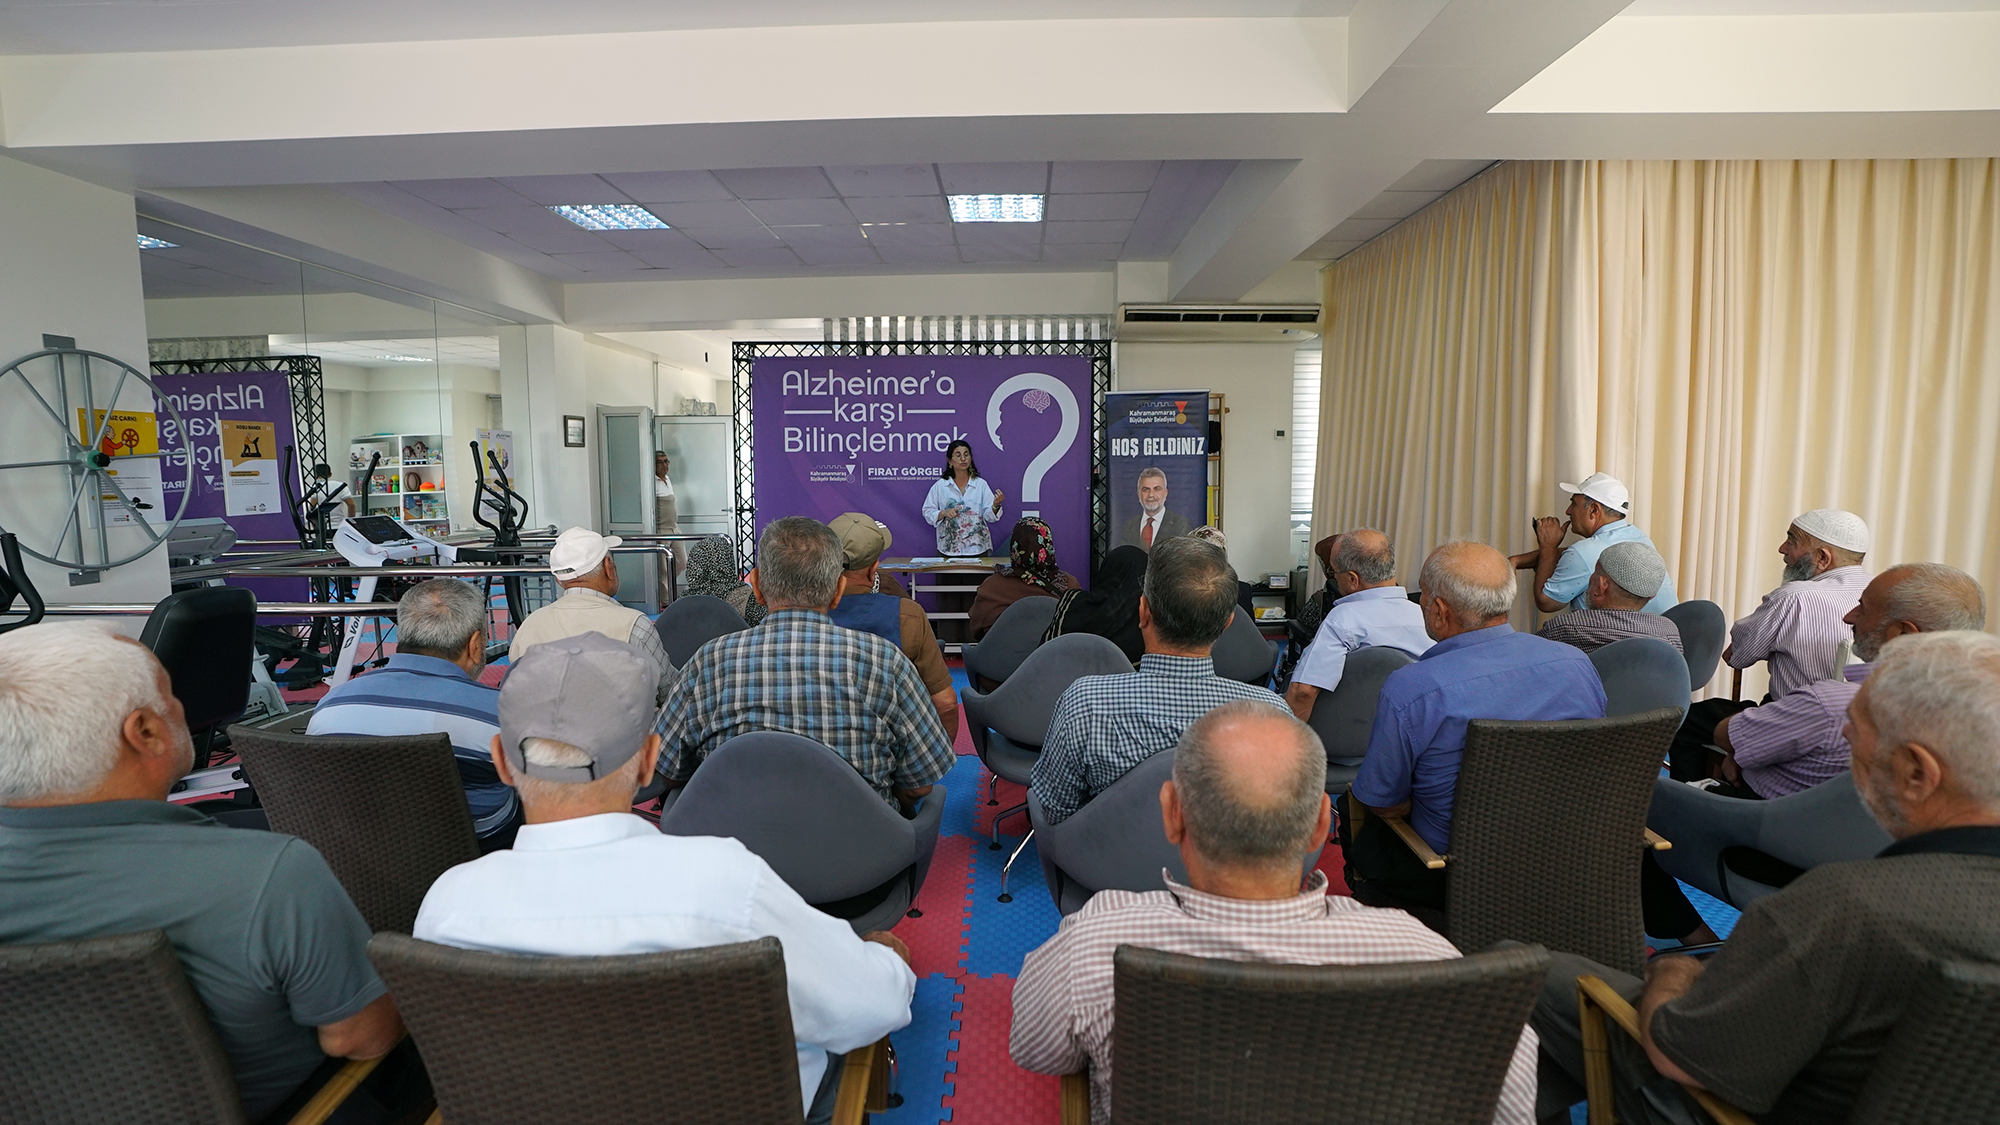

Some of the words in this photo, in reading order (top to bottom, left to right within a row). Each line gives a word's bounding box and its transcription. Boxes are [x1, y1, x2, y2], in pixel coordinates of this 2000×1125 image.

[782, 369, 955, 396] Alzheimer'a
[834, 397, 903, 429] karşı
[1129, 416, 1153, 424] Büyükşehir
[1154, 416, 1176, 424] Belediyesi
[784, 426, 968, 459] Bilinçlenmek
[1111, 438, 1139, 458] HOŞ
[1143, 437, 1205, 456] GELDİNİZ
[867, 467, 899, 476] FIRAT
